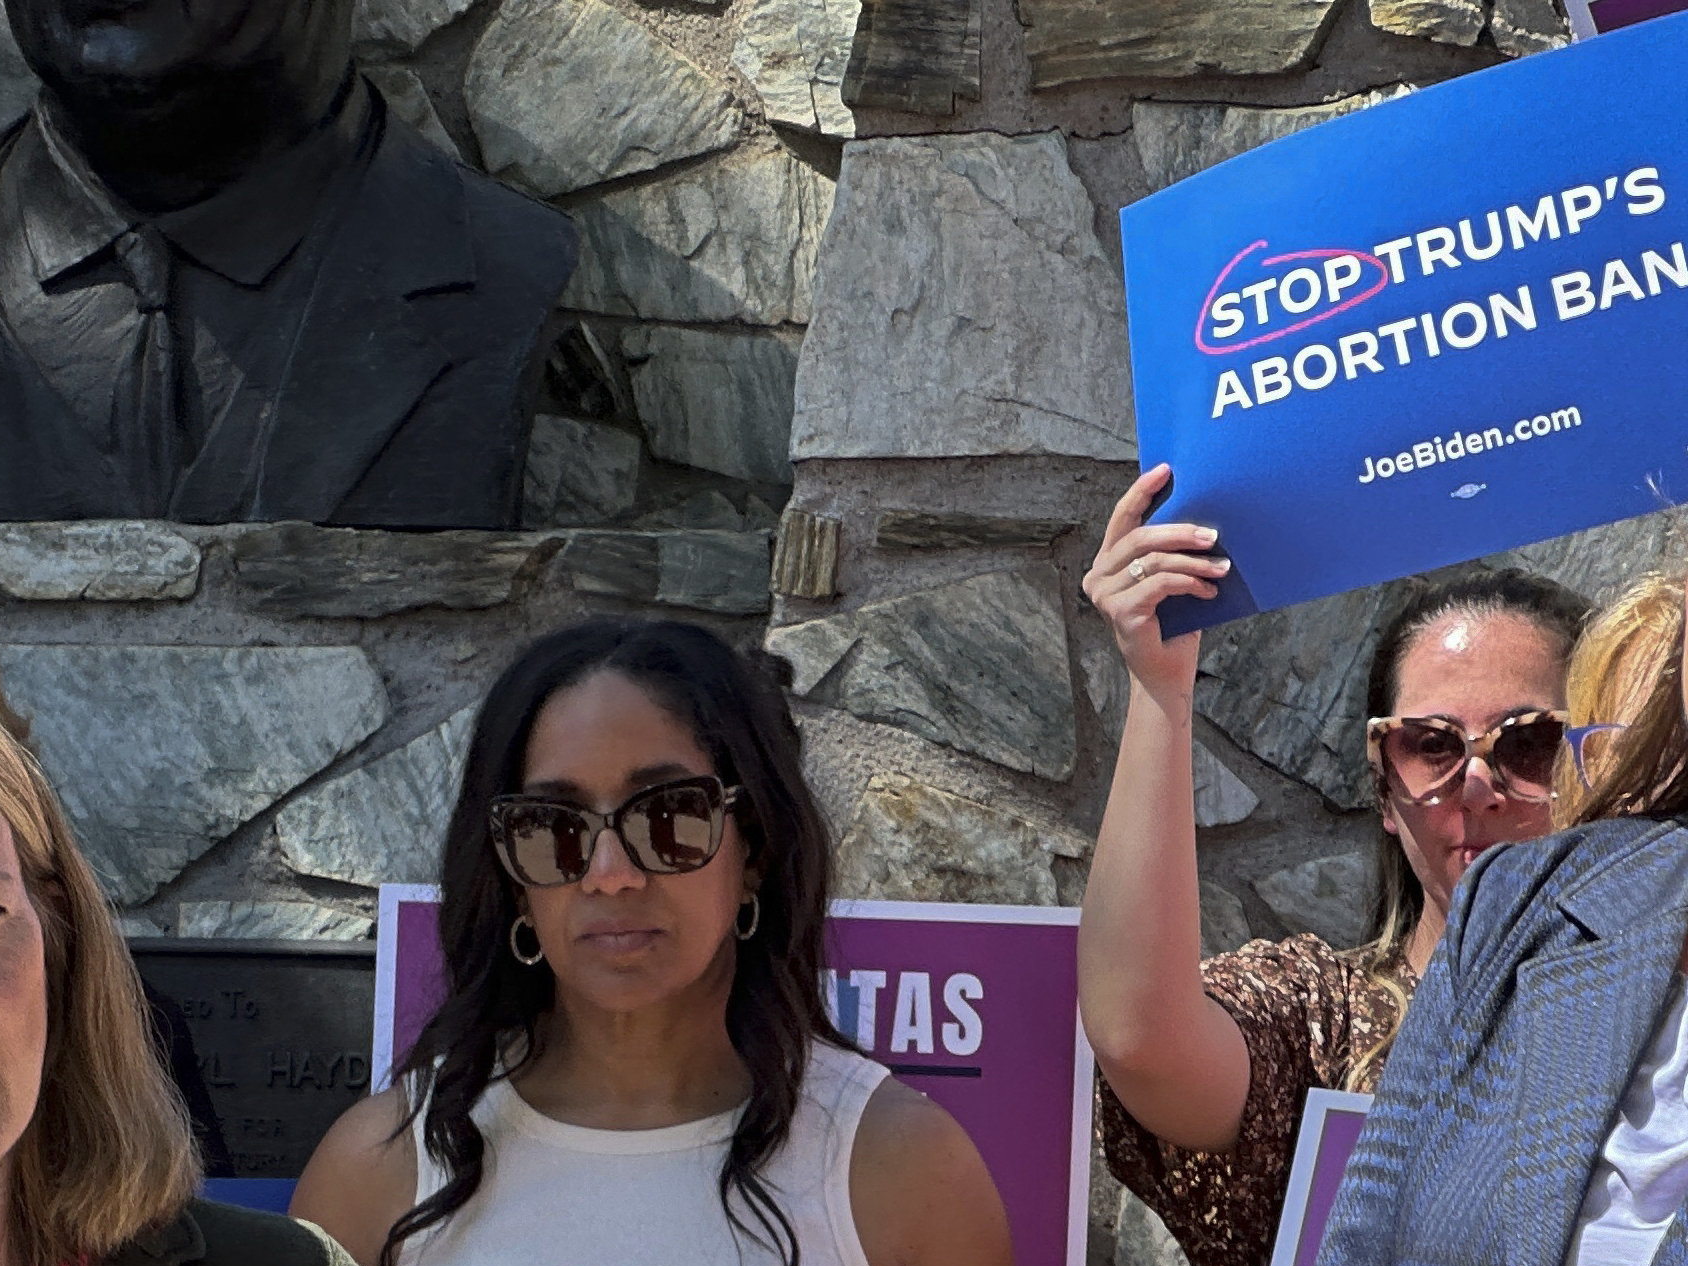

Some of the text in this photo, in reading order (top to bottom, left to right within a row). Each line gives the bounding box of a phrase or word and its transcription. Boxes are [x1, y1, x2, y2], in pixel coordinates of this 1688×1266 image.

[1211, 166, 1666, 338] STOP TRUMP'S
[1211, 242, 1688, 418] ABORTION BAN
[1358, 406, 1583, 484] JoeBiden.com
